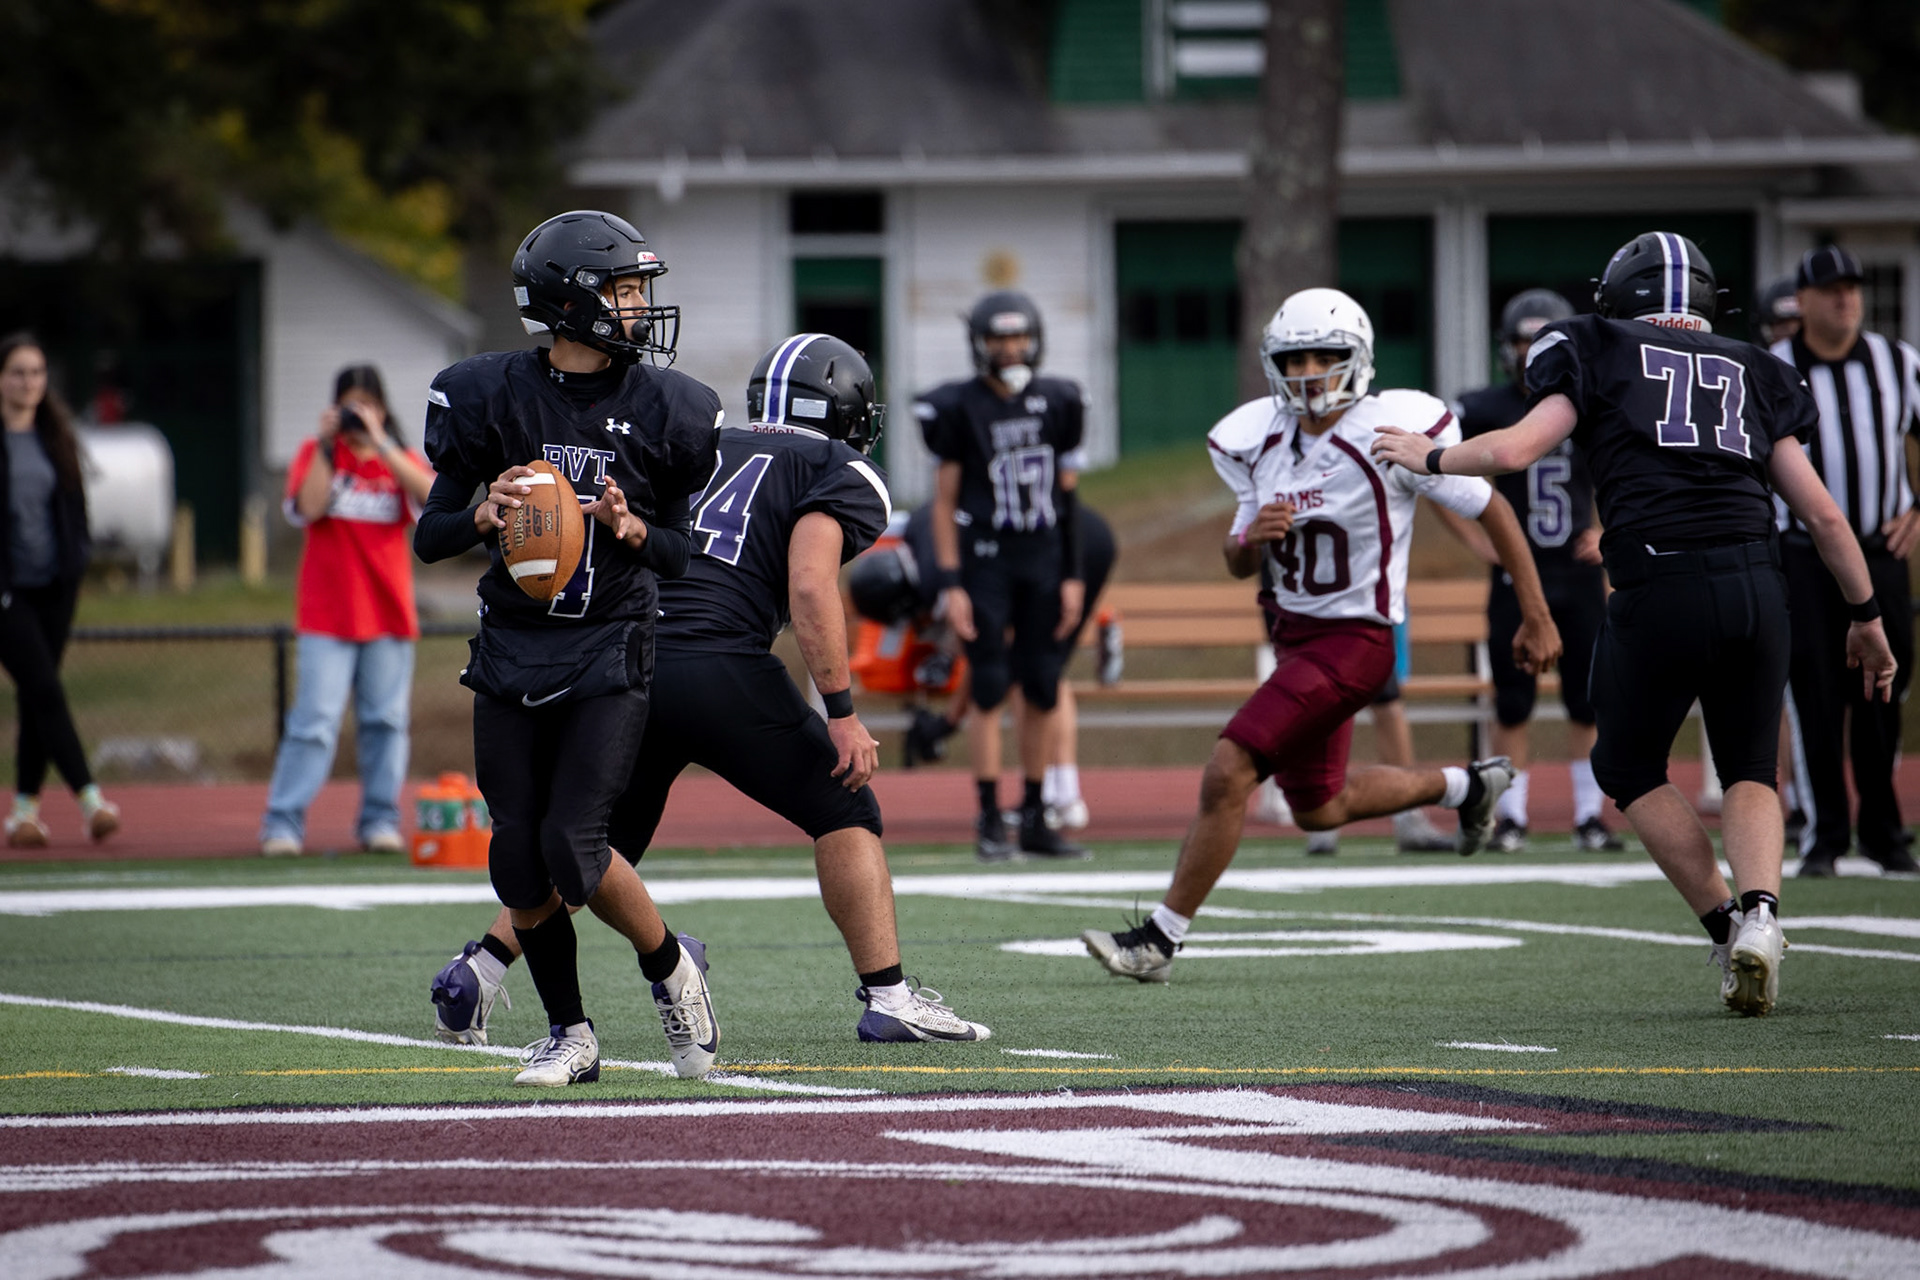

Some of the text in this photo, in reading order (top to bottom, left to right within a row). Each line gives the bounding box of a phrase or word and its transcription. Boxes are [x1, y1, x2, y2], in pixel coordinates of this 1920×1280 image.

[1640, 343, 1751, 459] 77
[543, 444, 615, 485] BVT
[988, 445, 1057, 532] 17
[1275, 489, 1324, 510] RAMS
[1527, 454, 1573, 549] 5
[532, 504, 542, 537] GST
[544, 510, 553, 532] NCAA
[689, 450, 774, 566] 4
[1270, 519, 1352, 597] 40
